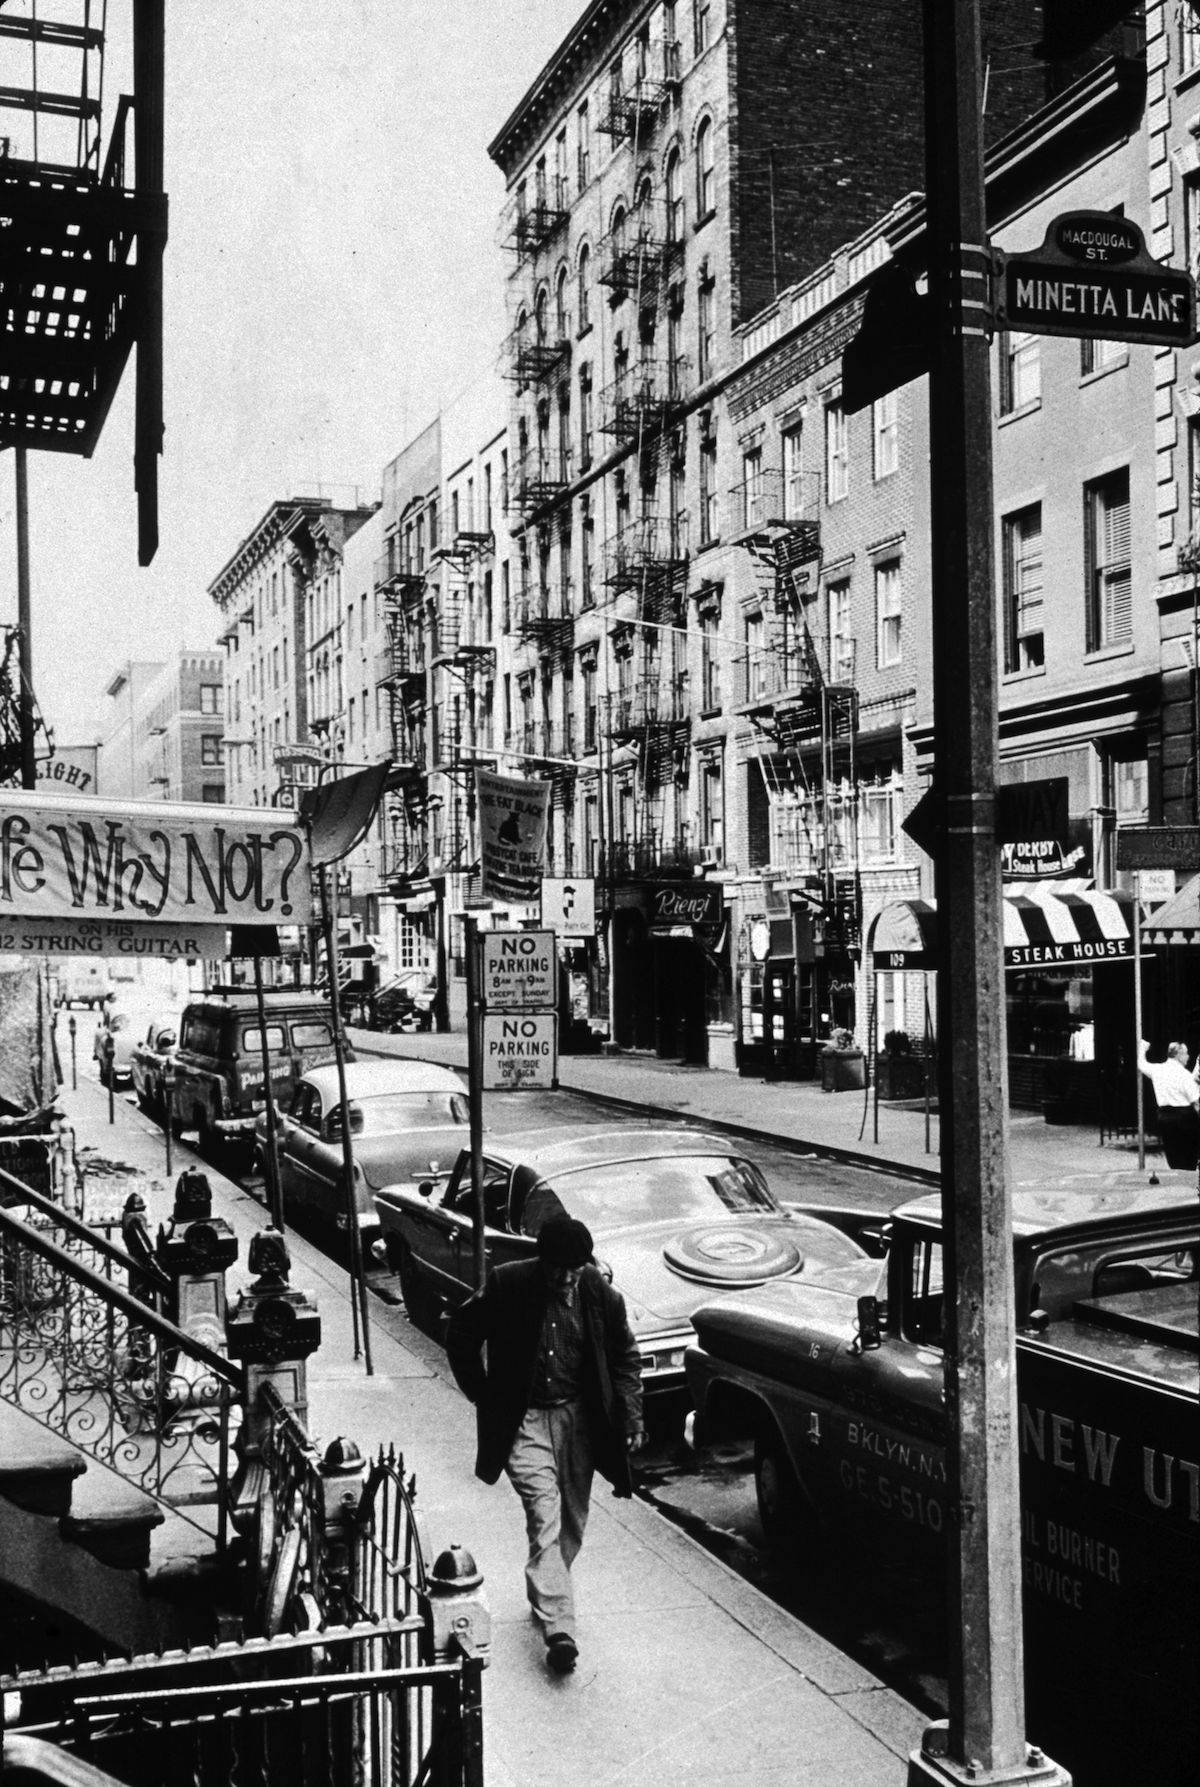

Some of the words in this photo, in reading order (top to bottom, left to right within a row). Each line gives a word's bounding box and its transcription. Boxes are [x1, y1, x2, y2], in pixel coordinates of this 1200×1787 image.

[1062, 230, 1134, 249] MACDOUGAL
[1085, 248, 1108, 261] ST.
[1016, 277, 1118, 317] MINETTA
[1126, 287, 1185, 323] LANE
[1016, 840, 1055, 858] DERBY
[47, 820, 171, 917] Why
[180, 827, 303, 917] Not?
[655, 889, 712, 923] Rienzi
[78, 924, 100, 936] ON
[105, 925, 134, 937] HIS
[21, 934, 104, 952] STRING
[117, 937, 201, 954] GUITAR
[502, 937, 537, 956] NO
[1012, 947, 1064, 963] STEAK
[1073, 940, 1127, 958] HOUSE
[489, 957, 549, 974] PARKING
[890, 953, 905, 967] 109
[488, 990, 516, 999] EXCEPT
[521, 989, 550, 998] SUNDAY
[502, 1020, 537, 1038] NO
[489, 1041, 550, 1056] PARKING
[498, 1059, 515, 1070] THIS
[523, 1059, 540, 1069] SIDE
[516, 1068, 536, 1079] SIGN
[808, 1341, 821, 1360] 16
[1020, 1402, 1121, 1487] NEW
[1046, 1519, 1121, 1584] BURNER
[1023, 1555, 1083, 1611] ERVICE
